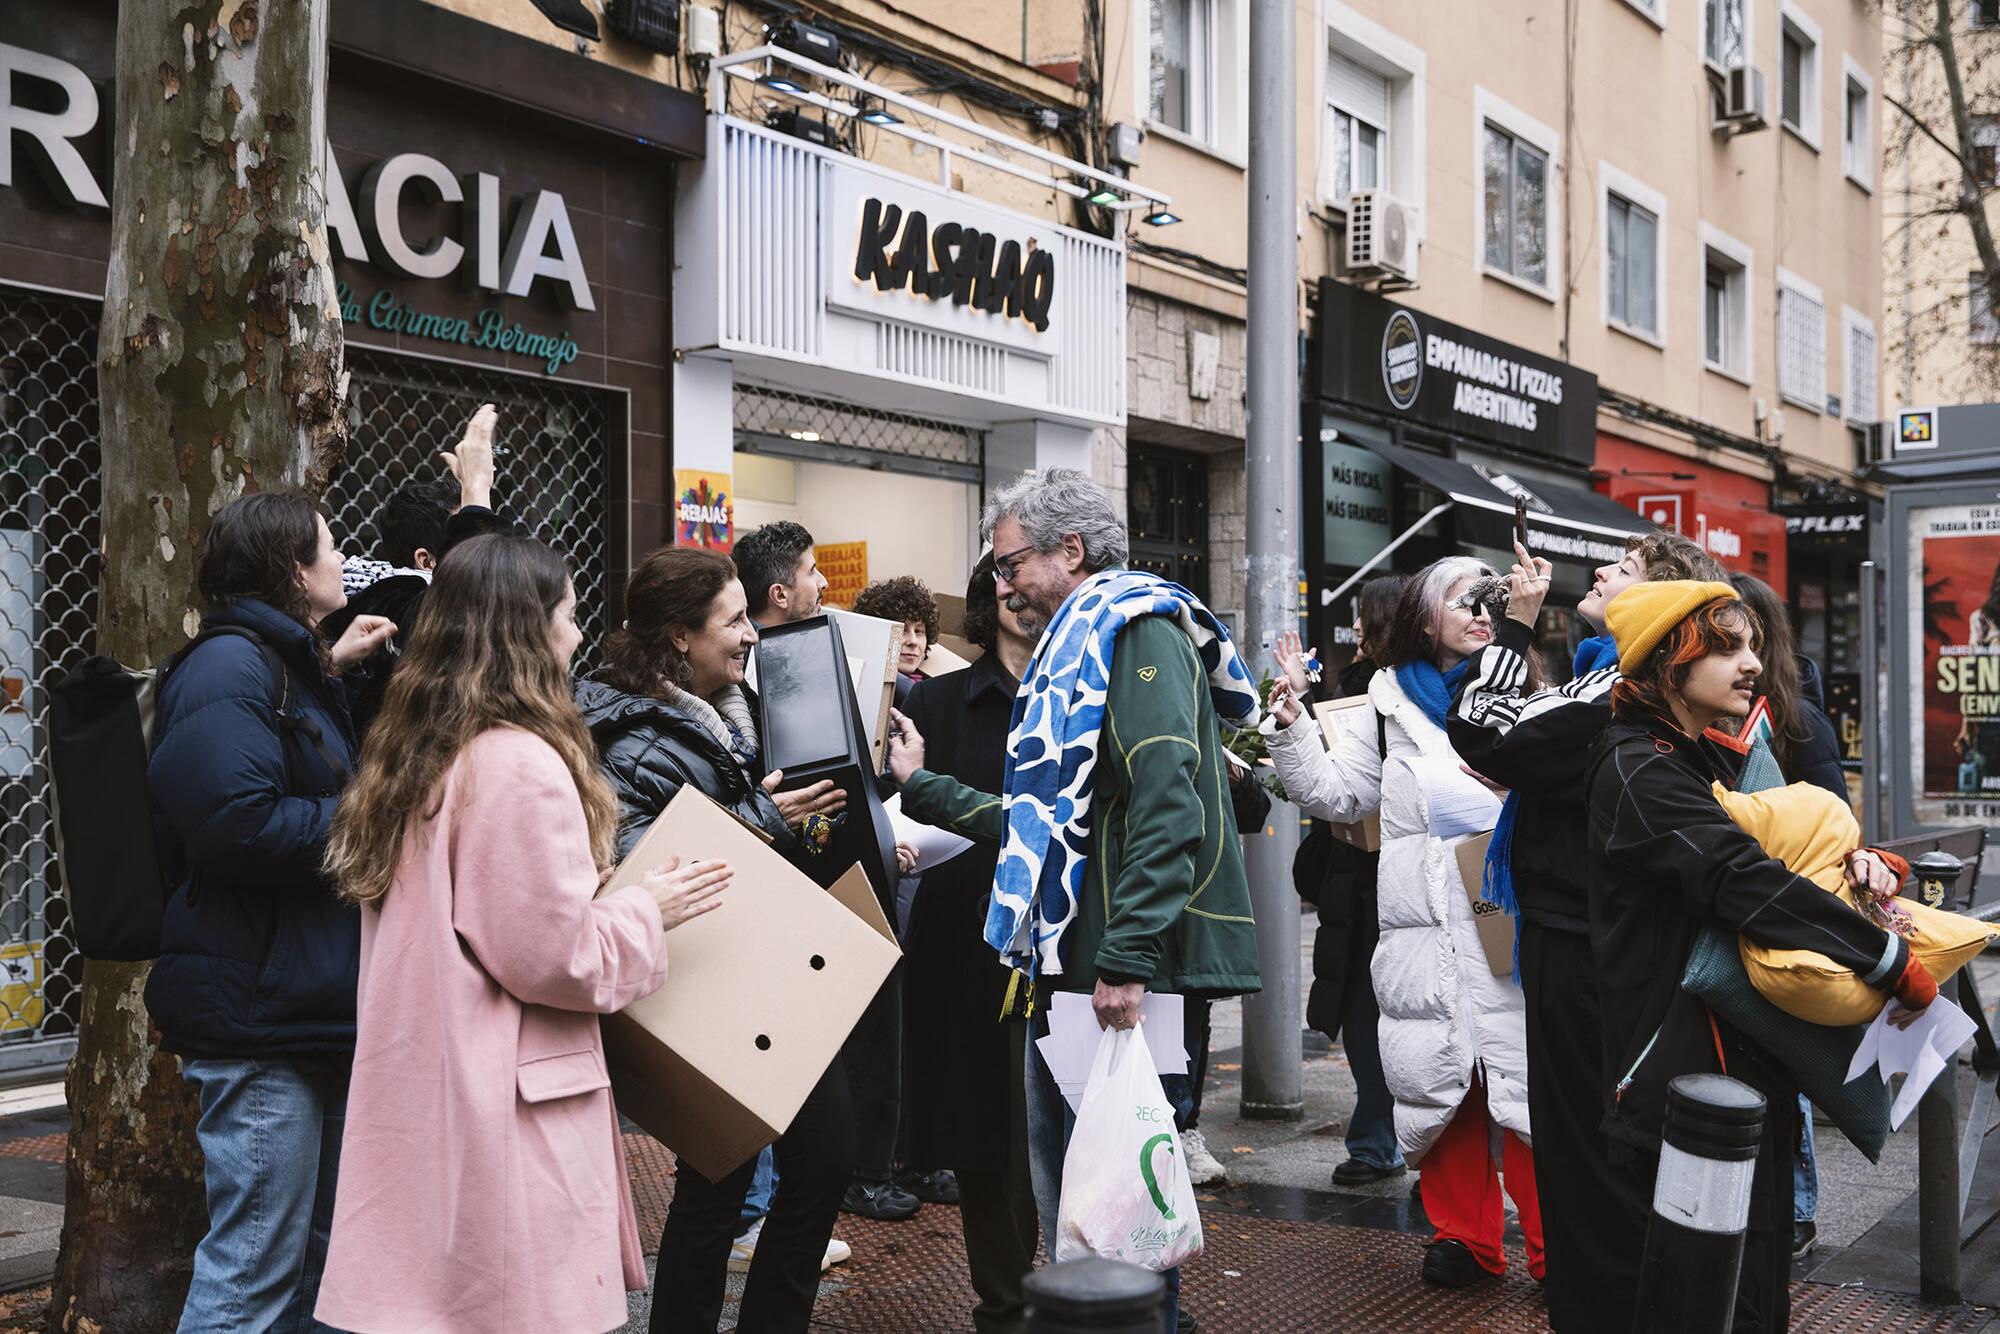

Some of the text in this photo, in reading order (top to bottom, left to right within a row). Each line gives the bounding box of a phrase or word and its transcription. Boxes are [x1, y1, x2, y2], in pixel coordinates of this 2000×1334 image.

[369, 288, 470, 345] Carmen
[473, 308, 578, 375] Bermejo
[1426, 333, 1563, 405] EMPANADAS Y PIZZAS
[1453, 380, 1538, 431] ARGENTINAS
[1331, 461, 1351, 486] MÁS
[680, 503, 728, 525] REBAJAS
[1326, 495, 1388, 525] MÁS GRANDES
[818, 548, 862, 563] REBAJAS
[1937, 656, 2000, 693] SEN
